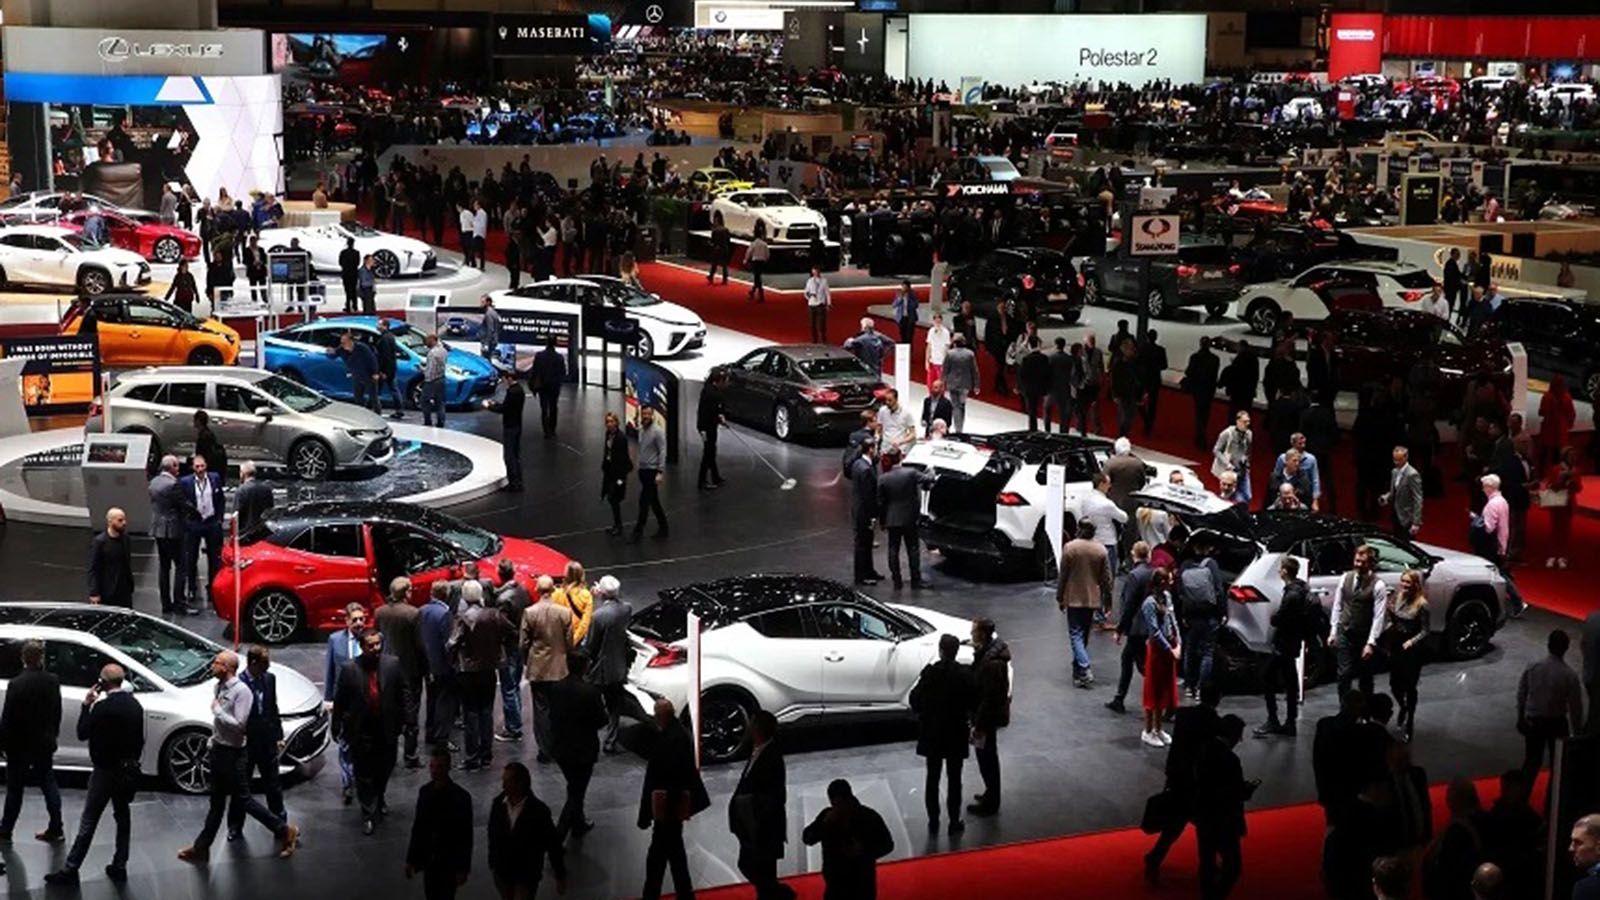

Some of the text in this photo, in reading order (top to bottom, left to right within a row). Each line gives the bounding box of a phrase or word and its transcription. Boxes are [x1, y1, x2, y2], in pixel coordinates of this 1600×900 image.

[517, 27, 584, 38] MASERATI
[134, 43, 223, 58] LEXUS
[1079, 47, 1158, 67] Polestar 2
[960, 184, 1009, 195] YOKOHAMA
[58, 343, 93, 351] WITHOUT
